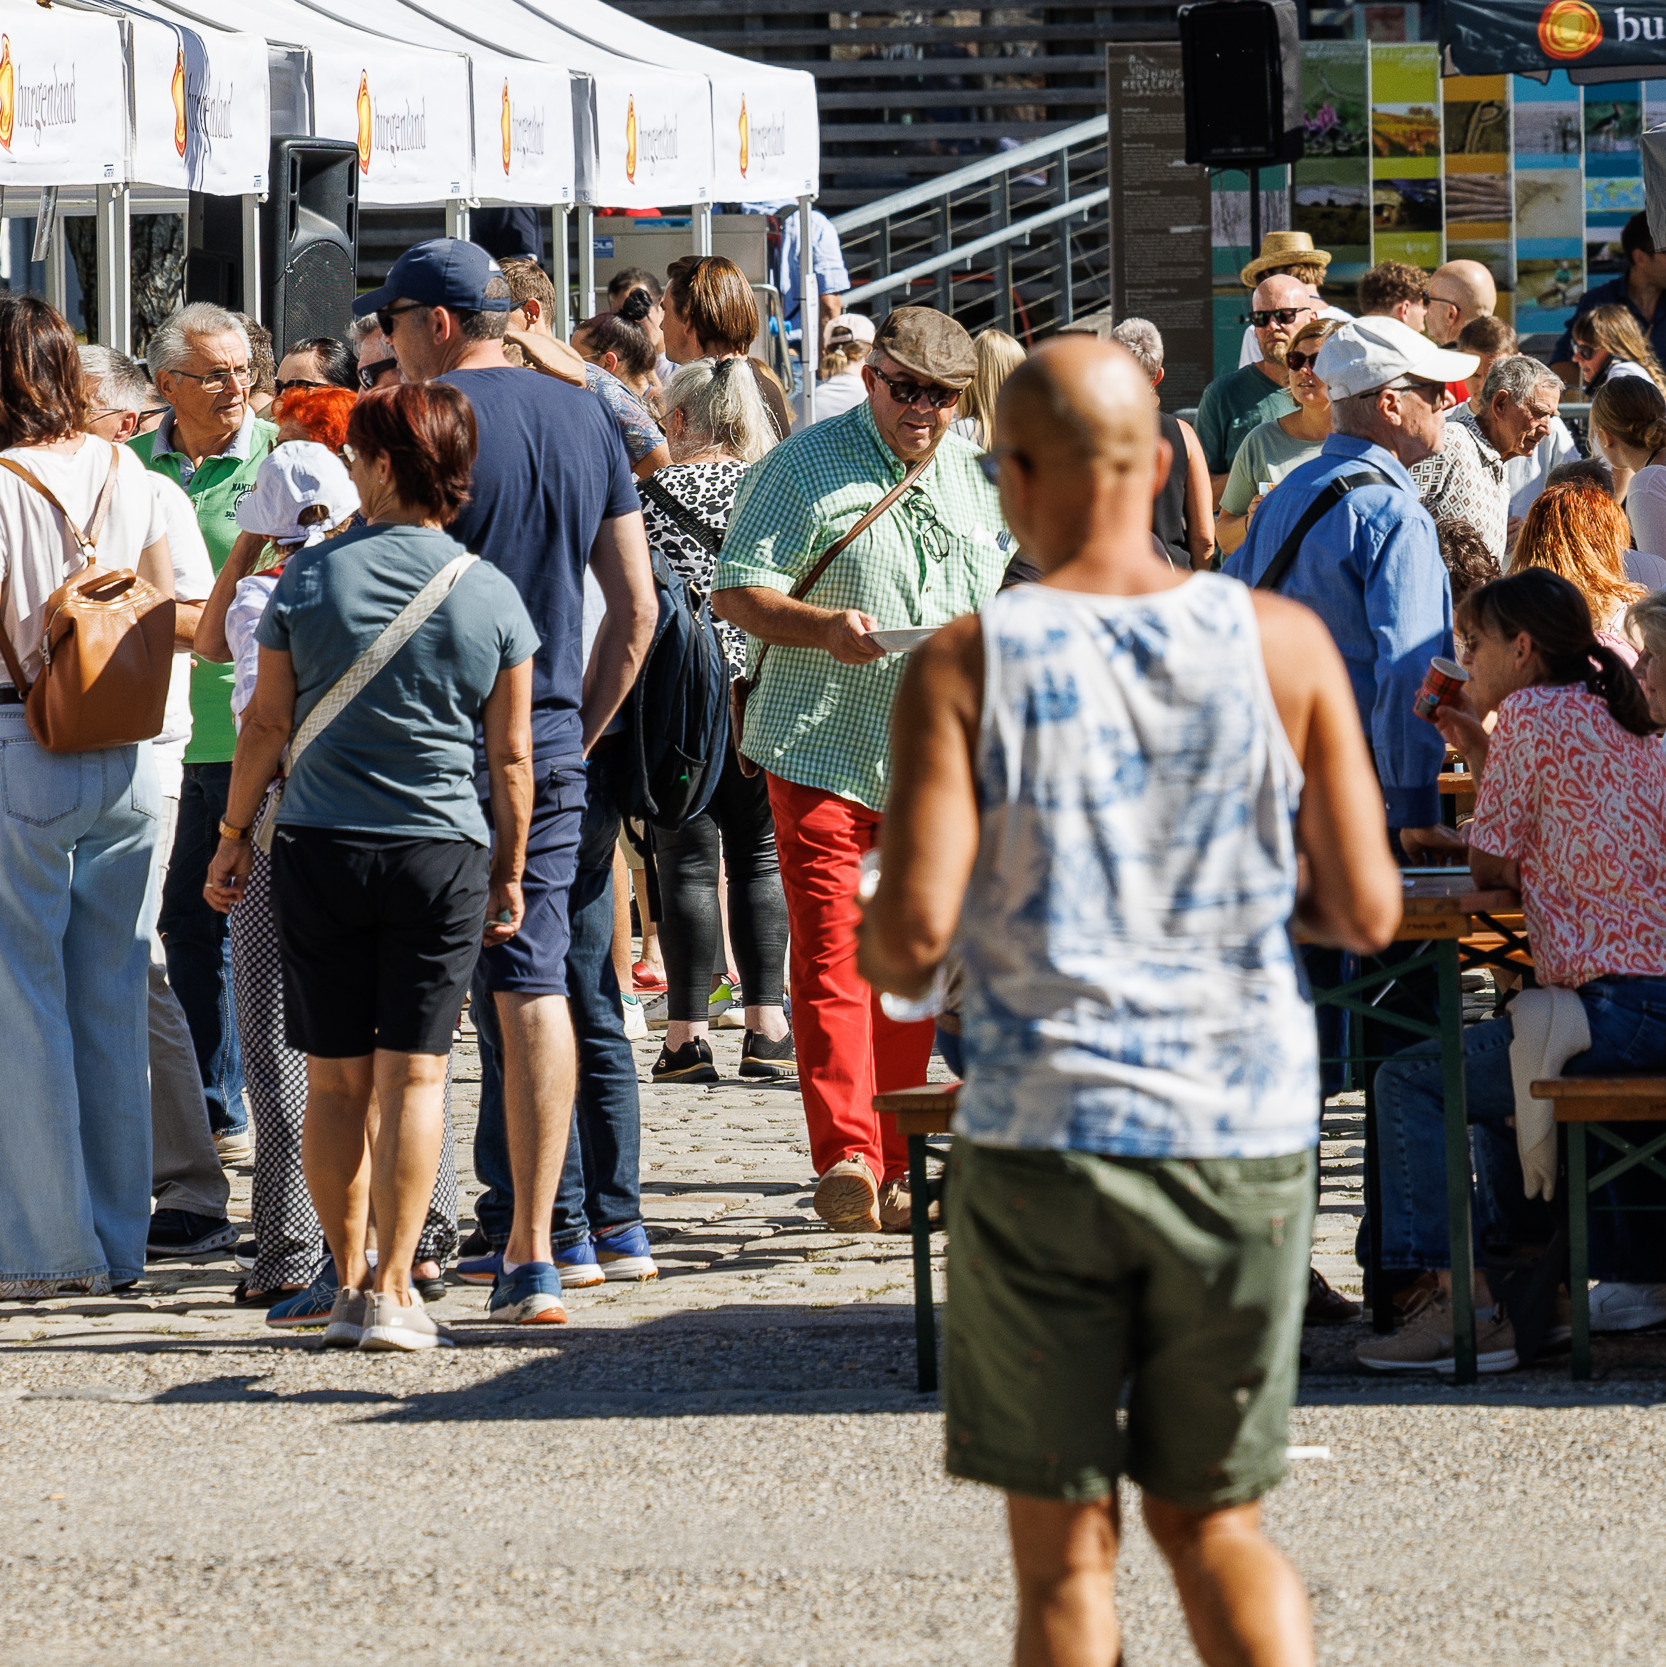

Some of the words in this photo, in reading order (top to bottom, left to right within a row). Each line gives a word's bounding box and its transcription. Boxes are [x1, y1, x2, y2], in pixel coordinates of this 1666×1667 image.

[17, 62, 77, 147] burgenland
[187, 70, 233, 154] burgenland
[374, 96, 427, 174] burgenland
[512, 102, 545, 173] burgenland
[638, 112, 679, 177] burgenland
[750, 111, 786, 178] burgenland
